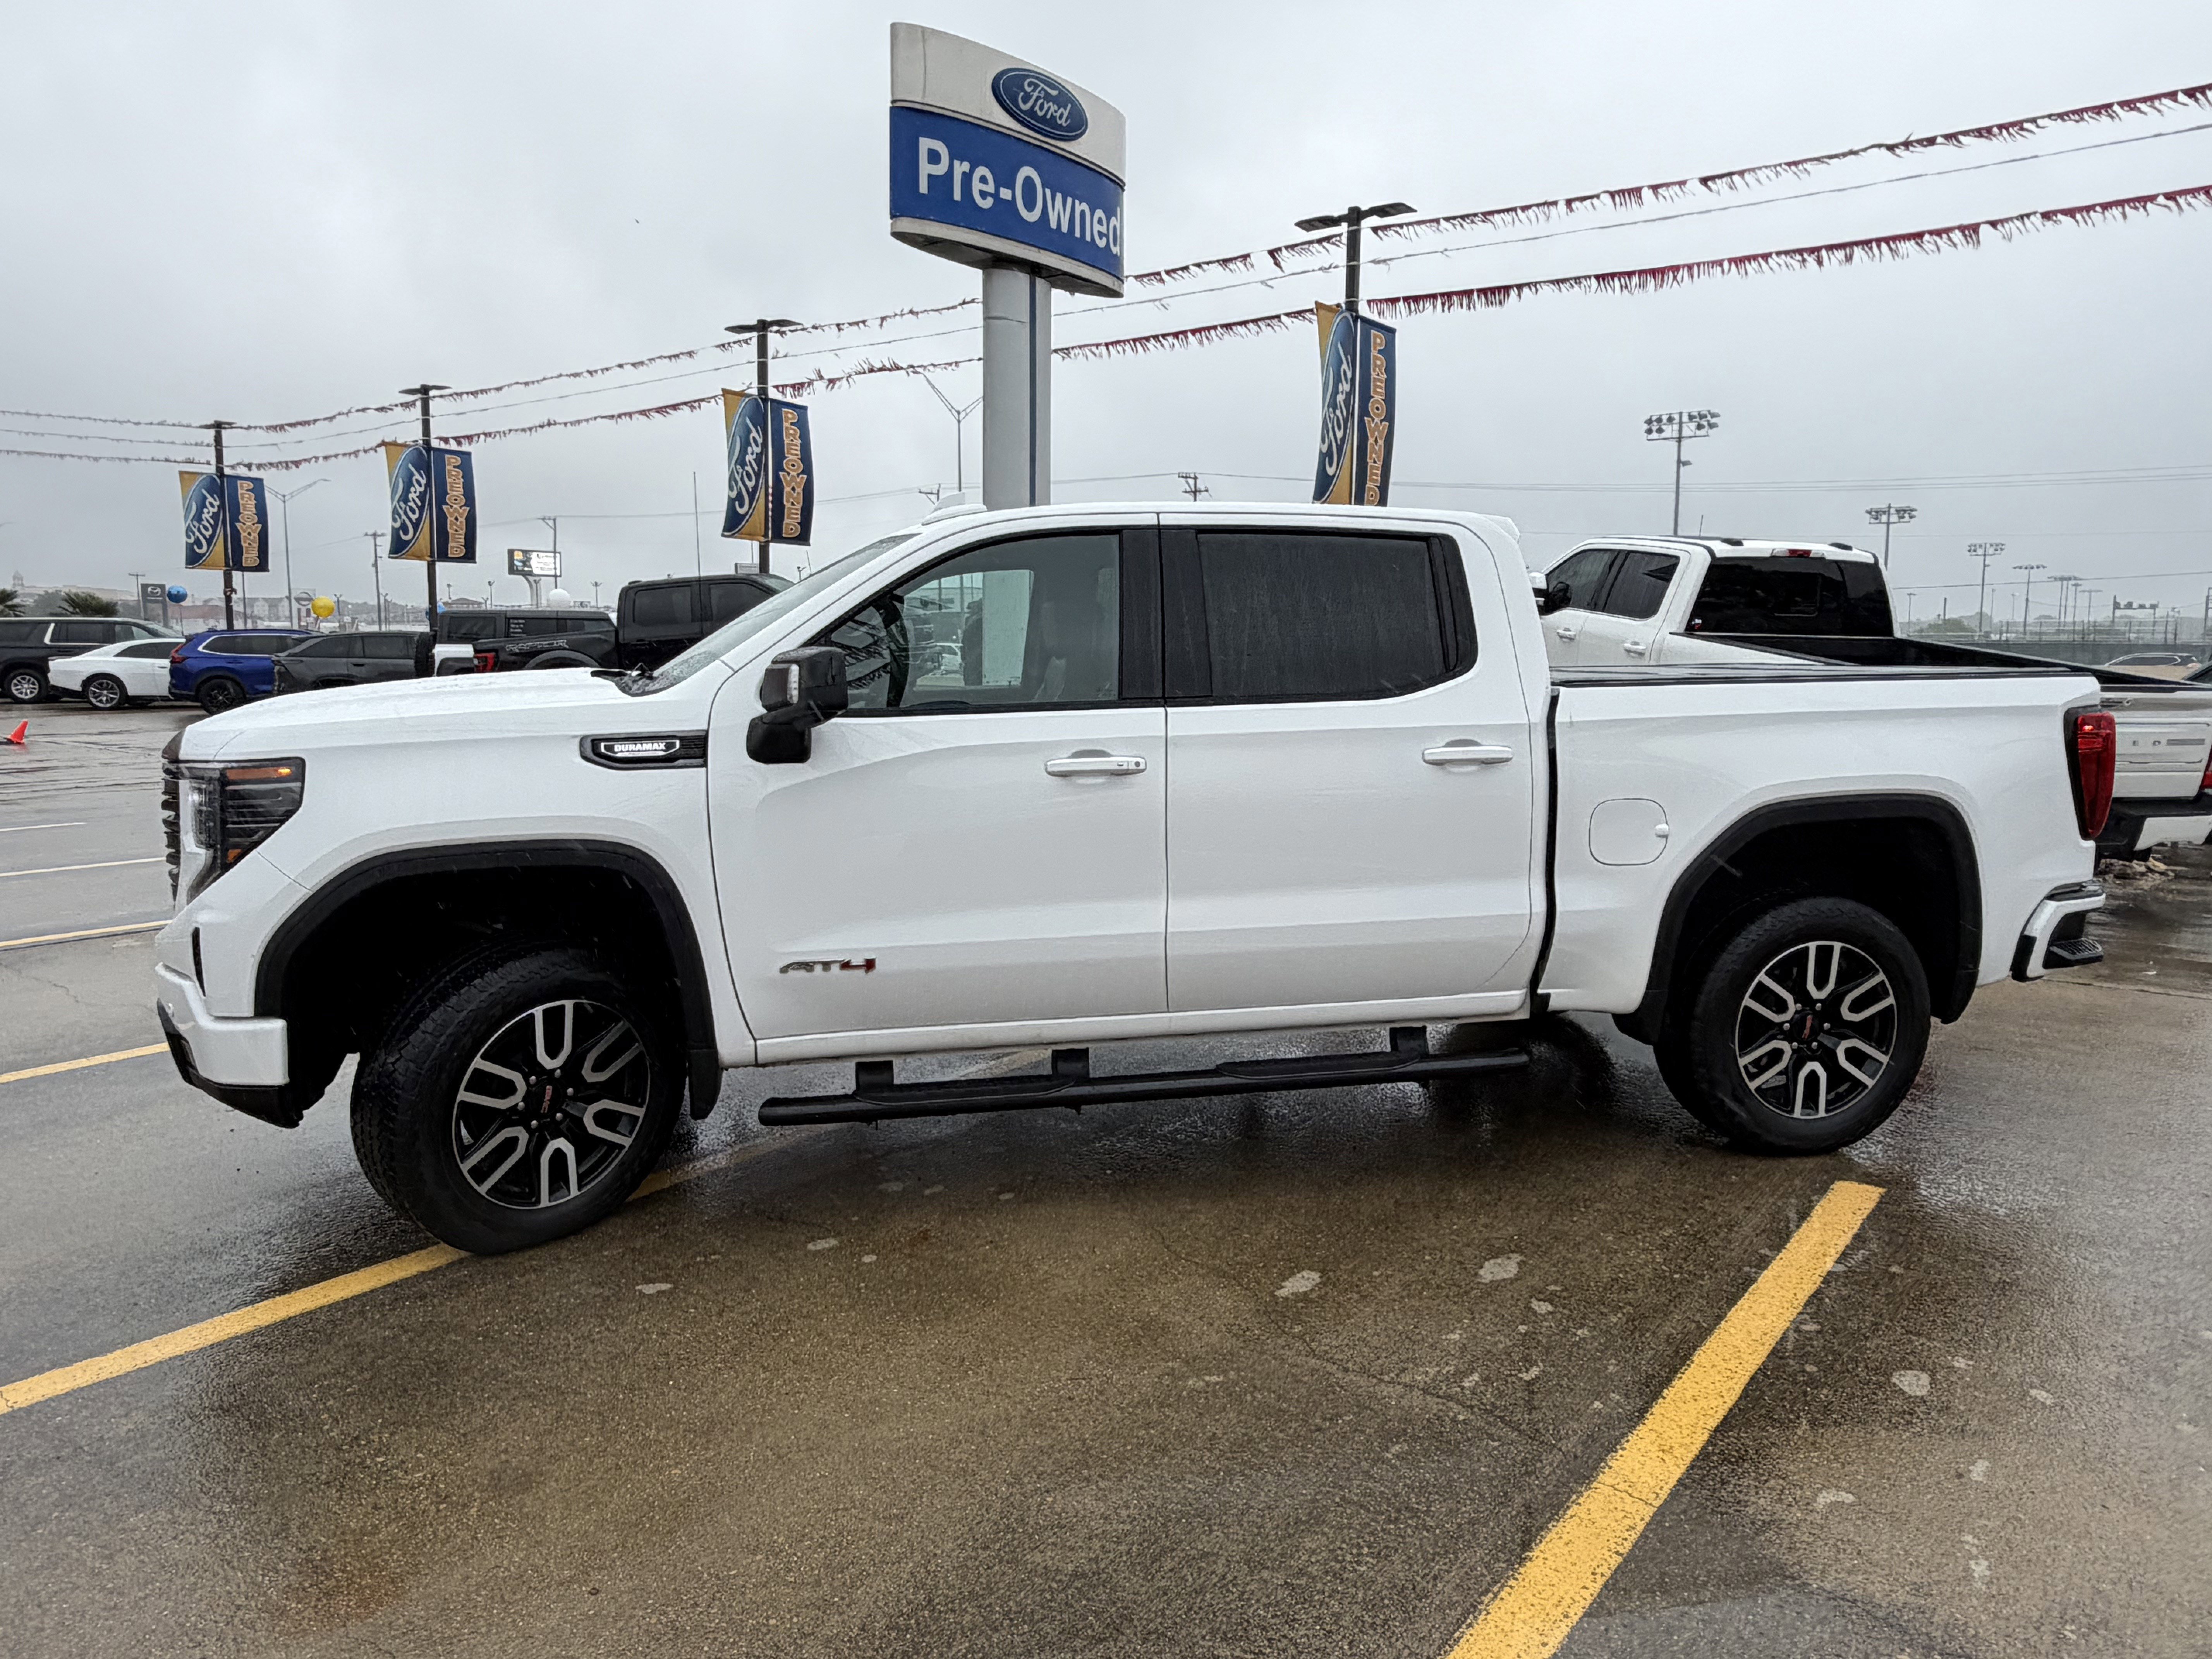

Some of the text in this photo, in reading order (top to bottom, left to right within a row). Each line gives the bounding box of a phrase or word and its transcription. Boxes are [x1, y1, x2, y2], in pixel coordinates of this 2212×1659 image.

[1018, 78, 1071, 127] Ford
[919, 137, 1121, 257] Pre-Owned
[1320, 341, 1352, 476] Ford
[1364, 330, 1389, 506] PREOWNED
[391, 462, 427, 541] Ford
[442, 454, 470, 558] PREOWNED
[728, 417, 764, 515] Ford
[779, 408, 807, 538] PREOWNED
[185, 488, 220, 554] Ford
[235, 480, 263, 567] PREOWNED
[614, 742, 666, 752] DURAMAX
[779, 958, 877, 974] AT4
